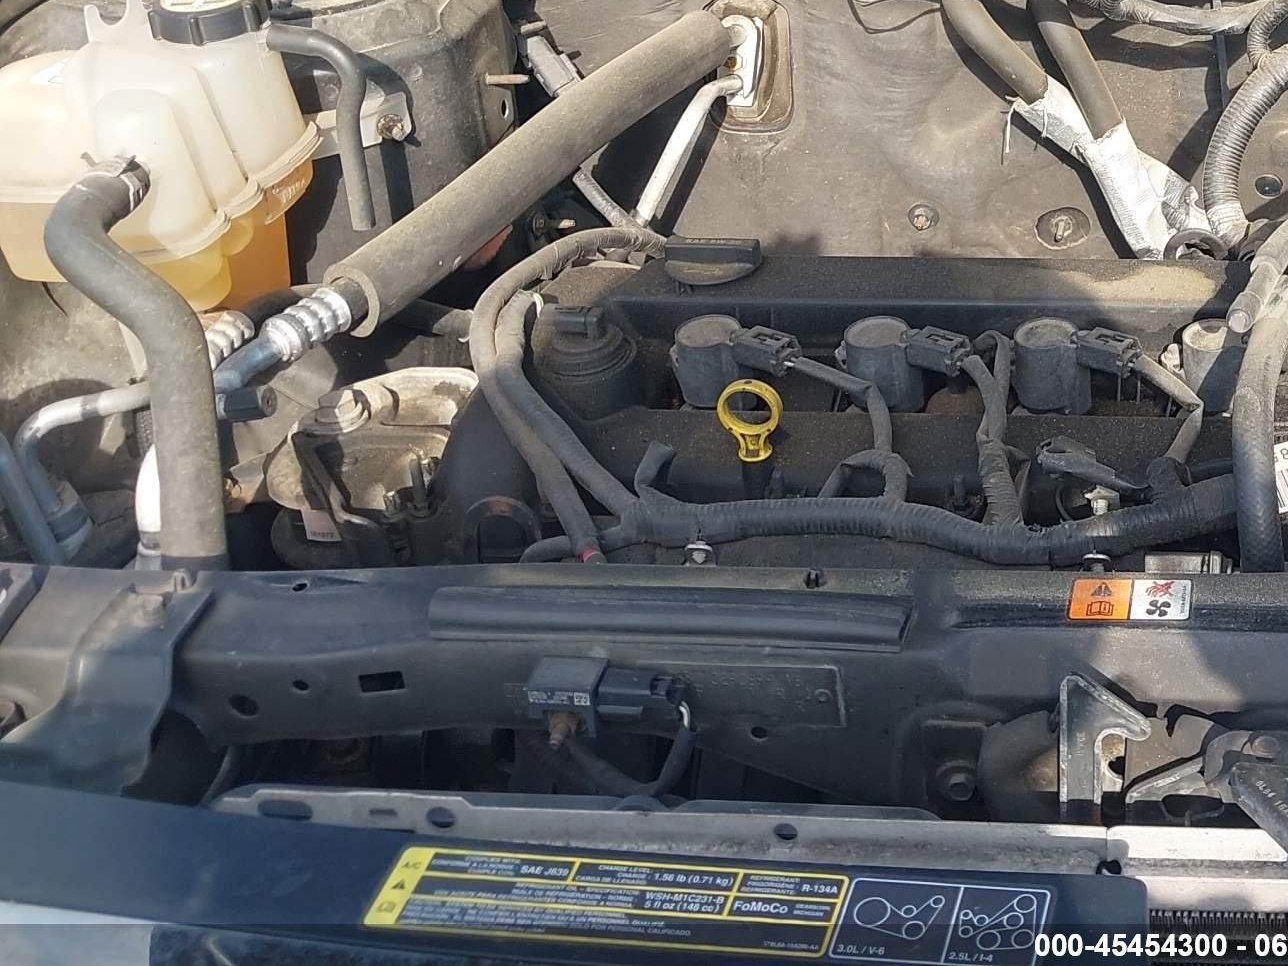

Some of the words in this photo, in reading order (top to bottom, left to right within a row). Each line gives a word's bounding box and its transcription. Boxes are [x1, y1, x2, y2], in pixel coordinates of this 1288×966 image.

[521, 865, 543, 875] SAE
[544, 867, 570, 877] J639
[654, 873, 674, 882] 1.56
[676, 874, 686, 883] lb
[688, 875, 713, 885] (0.71
[716, 876, 734, 887] kg)
[801, 884, 838, 895] R-134A
[702, 903, 720, 913] cc)
[733, 900, 788, 914] FoMoCo
[837, 944, 859, 954] 3.0L
[869, 946, 885, 955] V-6
[949, 951, 970, 960] 2.5L
